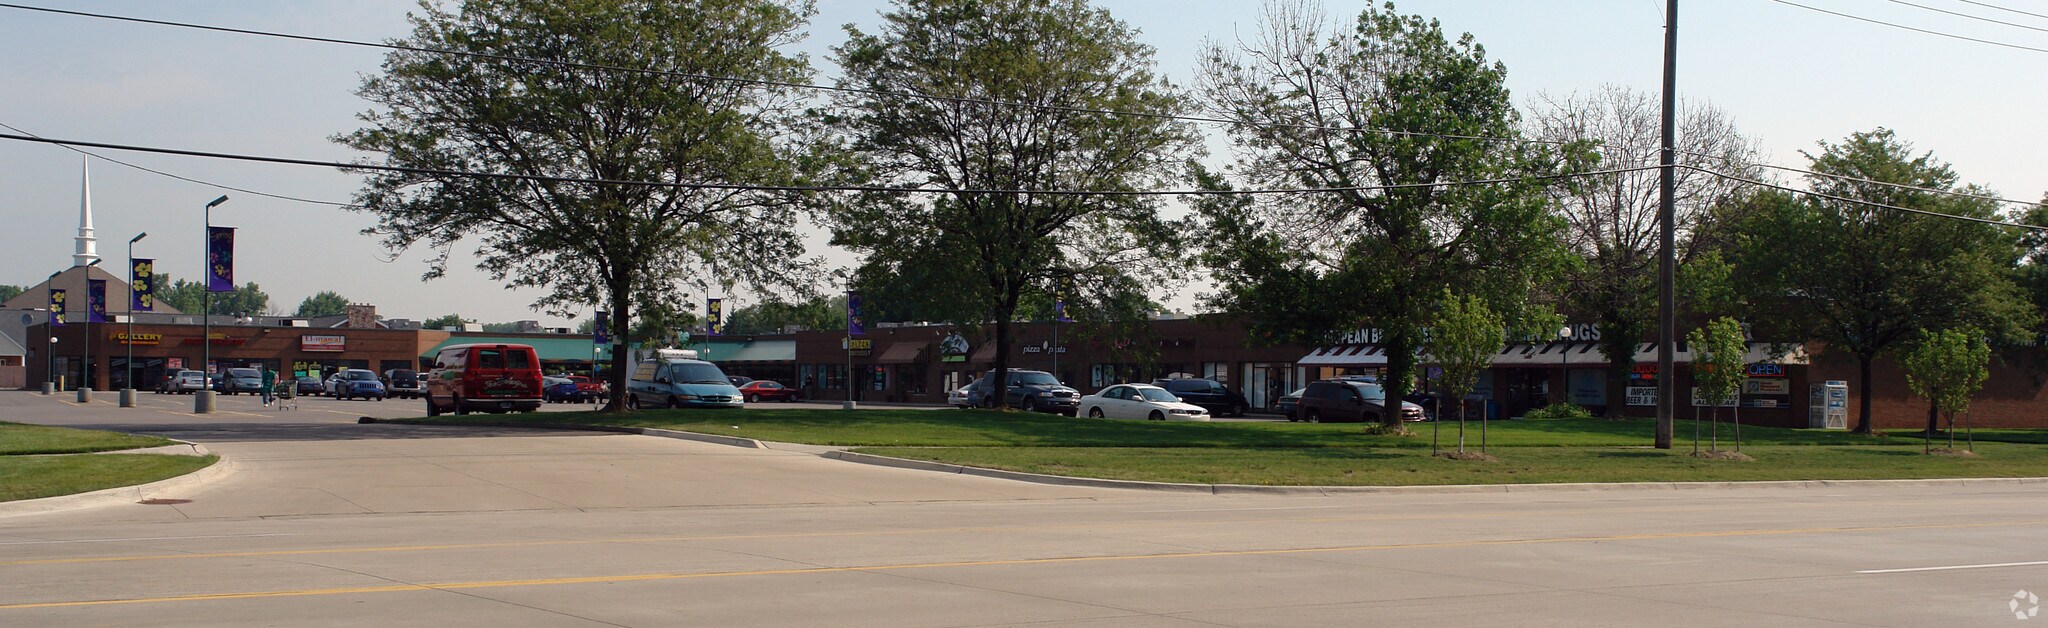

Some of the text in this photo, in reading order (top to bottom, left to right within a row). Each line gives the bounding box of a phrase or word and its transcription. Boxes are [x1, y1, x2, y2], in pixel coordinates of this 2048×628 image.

[118, 332, 162, 341] GALLERY
[1022, 345, 1041, 355] pizza
[1748, 363, 1782, 375] OPEN
[1630, 387, 1658, 396] IMPORTE
[1626, 396, 1641, 405] BEER
